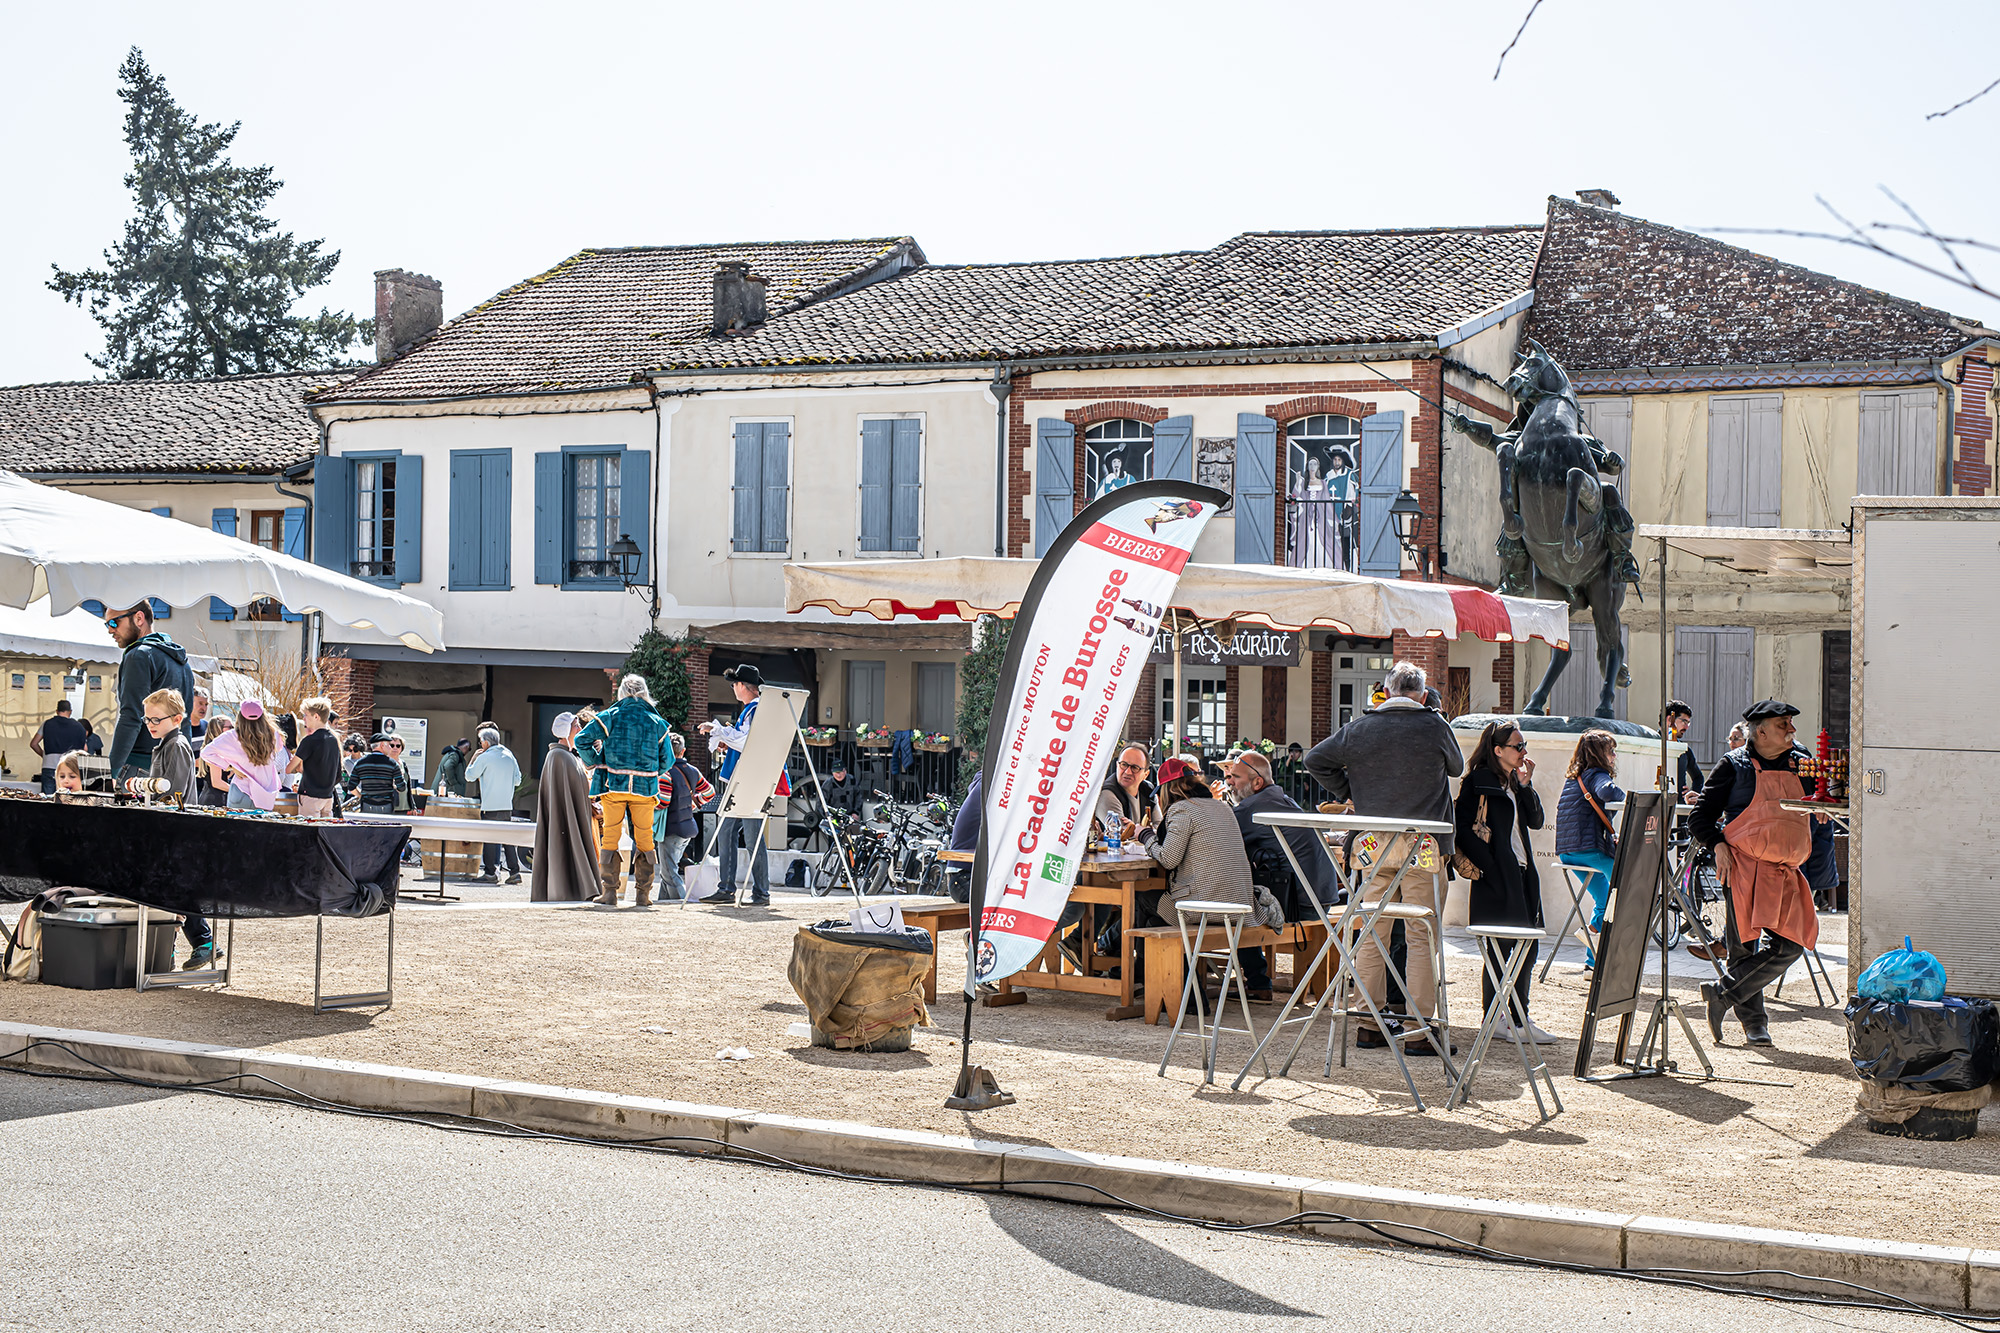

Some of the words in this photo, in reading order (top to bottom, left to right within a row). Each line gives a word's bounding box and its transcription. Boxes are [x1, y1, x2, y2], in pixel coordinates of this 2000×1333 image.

[1103, 532, 1165, 561] BIERES
[1062, 569, 1129, 691] Burosse
[1023, 643, 1051, 713] MOUTON
[1110, 644, 1131, 677] Gers
[1103, 680, 1118, 701] du
[1051, 695, 1080, 732] de
[1092, 704, 1110, 731] Bio
[1013, 715, 1030, 753] Brice
[1010, 755, 1020, 769] et
[1069, 732, 1101, 804] Paysanne
[999, 771, 1016, 809] Rémi
[1018, 737, 1067, 854] Cadette
[1058, 806, 1079, 846] Bière
[1003, 862, 1033, 899] La
[1049, 859, 1063, 882] AB
